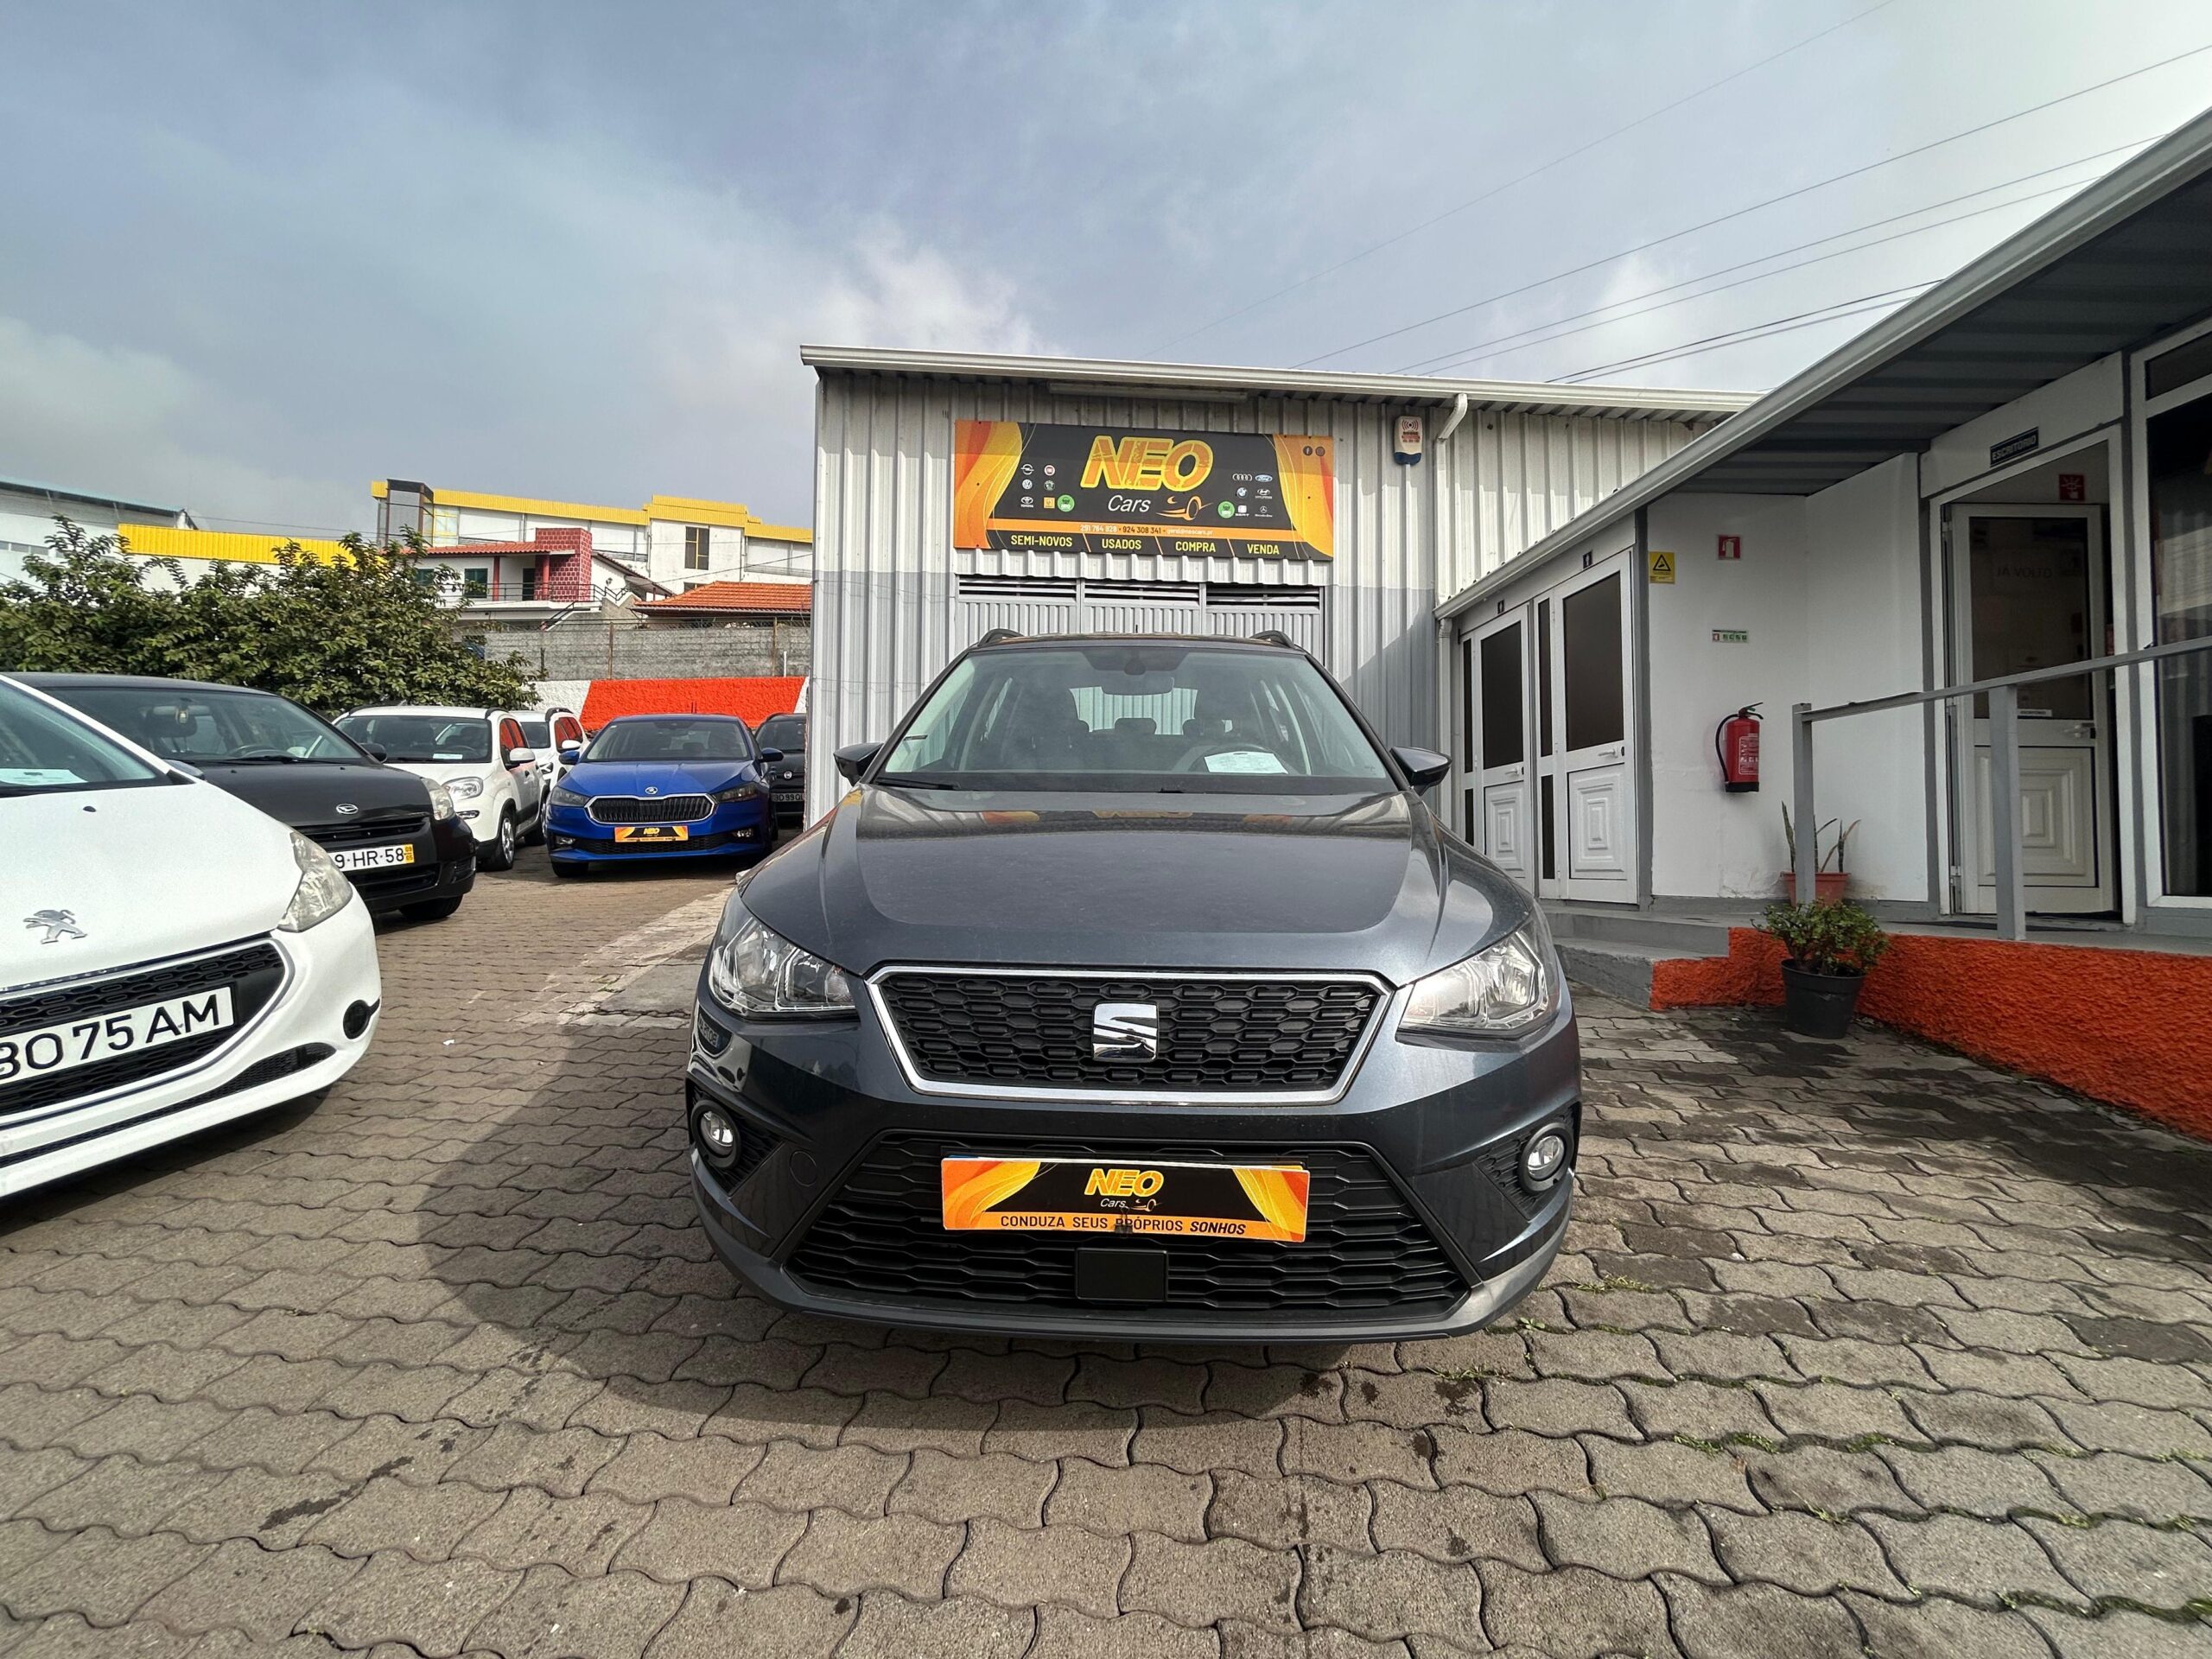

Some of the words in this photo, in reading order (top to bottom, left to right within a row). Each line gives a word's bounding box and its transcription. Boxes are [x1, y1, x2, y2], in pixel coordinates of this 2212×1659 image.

[1080, 435, 1213, 492] NEO
[1108, 494, 1151, 512] Cars
[1010, 535, 1072, 547] SEMI-NOVOS
[1102, 538, 1141, 550] USADOS
[1175, 541, 1217, 553] COMPRA
[1247, 543, 1280, 555] VENDA
[73, 1014, 135, 1062] 75
[145, 994, 219, 1044] AM
[1084, 1168, 1164, 1198] NEO
[1100, 1198, 1127, 1208] Cars
[1001, 1215, 1065, 1227] CONDUZA
[1072, 1217, 1108, 1229] SEUS
[1189, 1220, 1246, 1235] SONHOS
